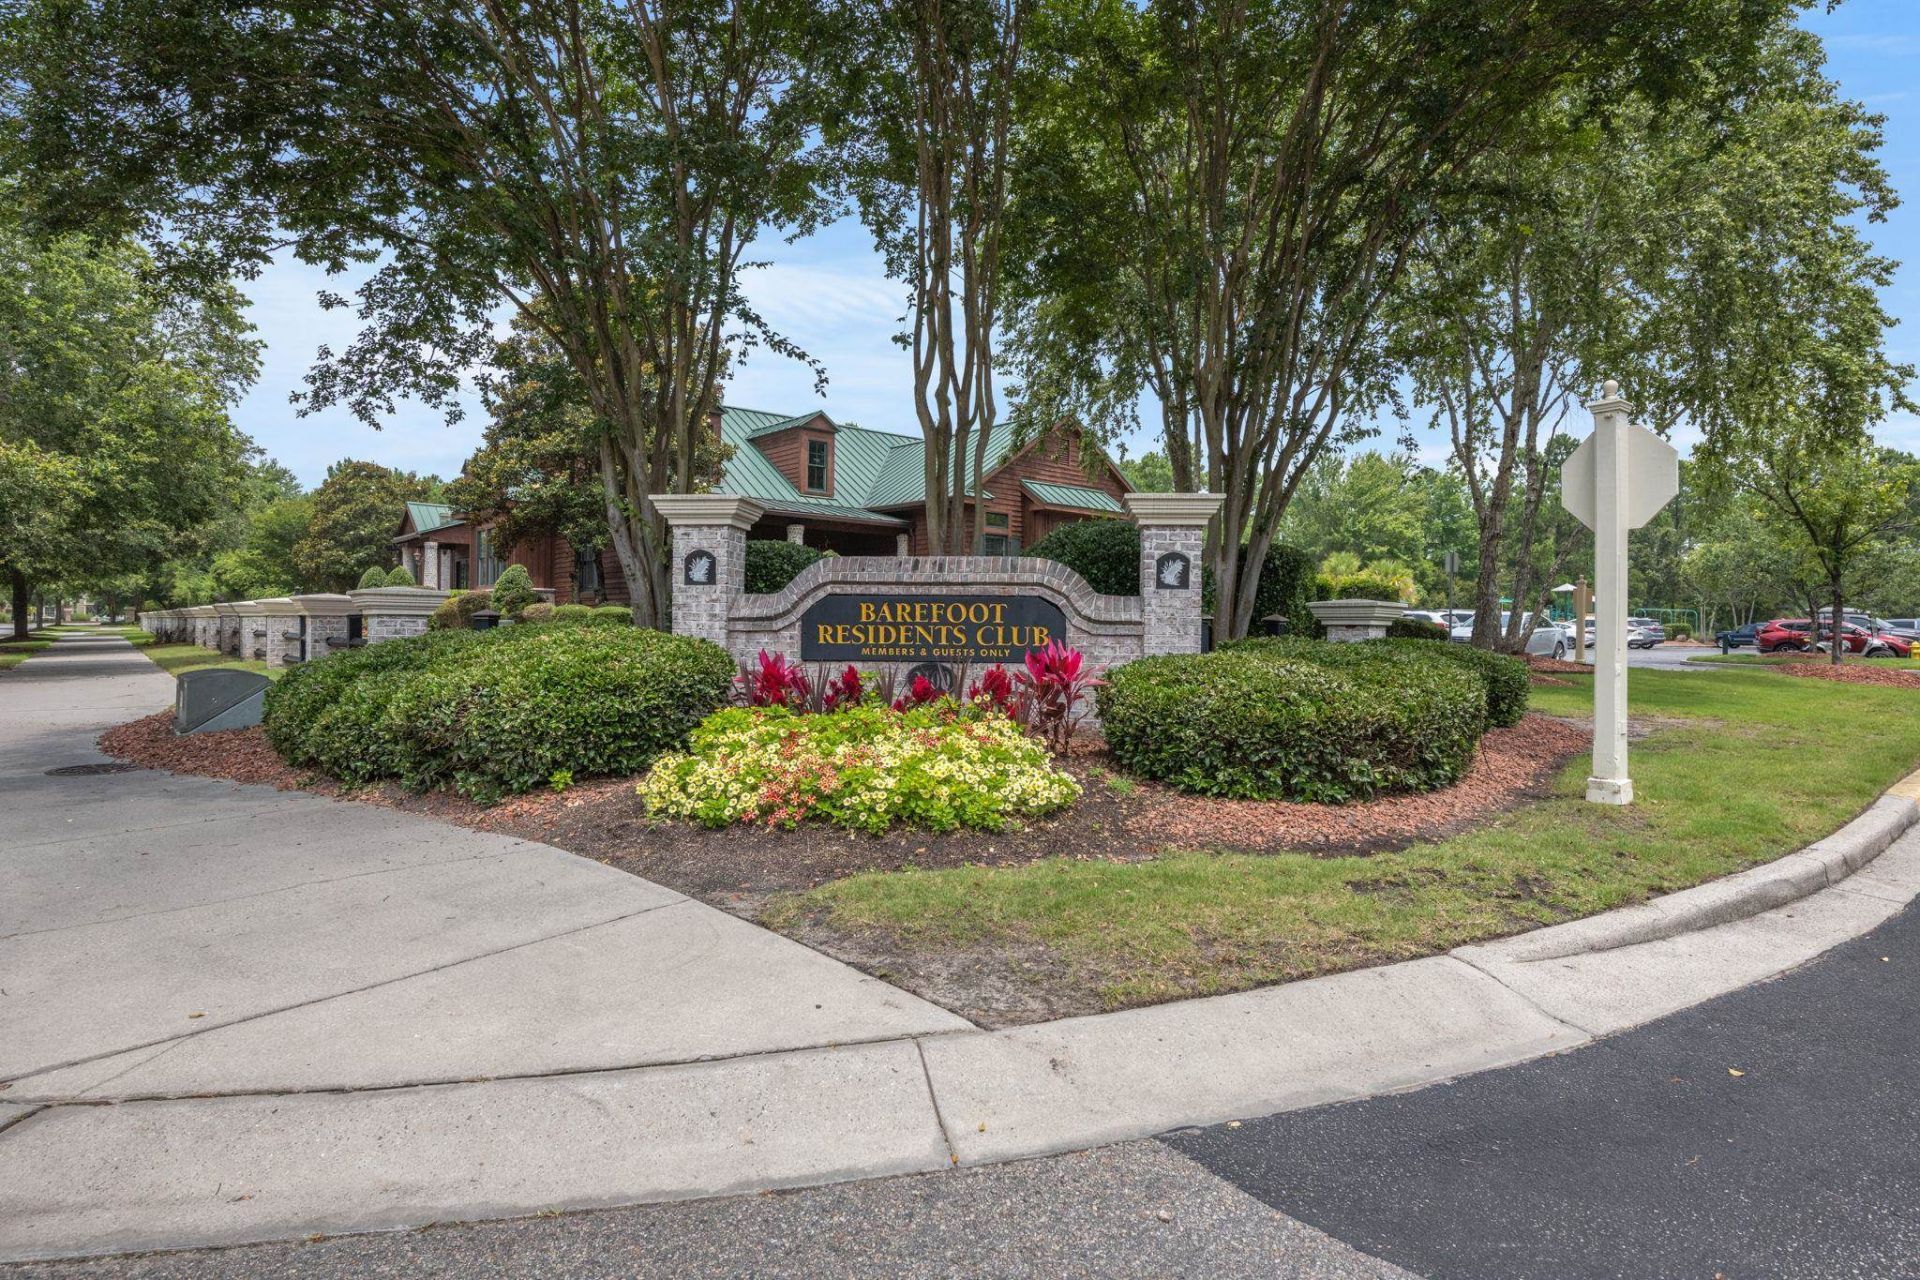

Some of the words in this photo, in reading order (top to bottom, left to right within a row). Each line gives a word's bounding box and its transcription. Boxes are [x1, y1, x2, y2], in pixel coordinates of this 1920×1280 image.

[859, 602, 1008, 623] BAREFOOT
[817, 624, 967, 646] RESIDENTS
[976, 625, 1050, 647] CLUB
[861, 647, 915, 656] MEMBERS
[920, 648, 927, 657] &
[933, 648, 975, 657] GUESTS
[980, 649, 1010, 657] ONLY
